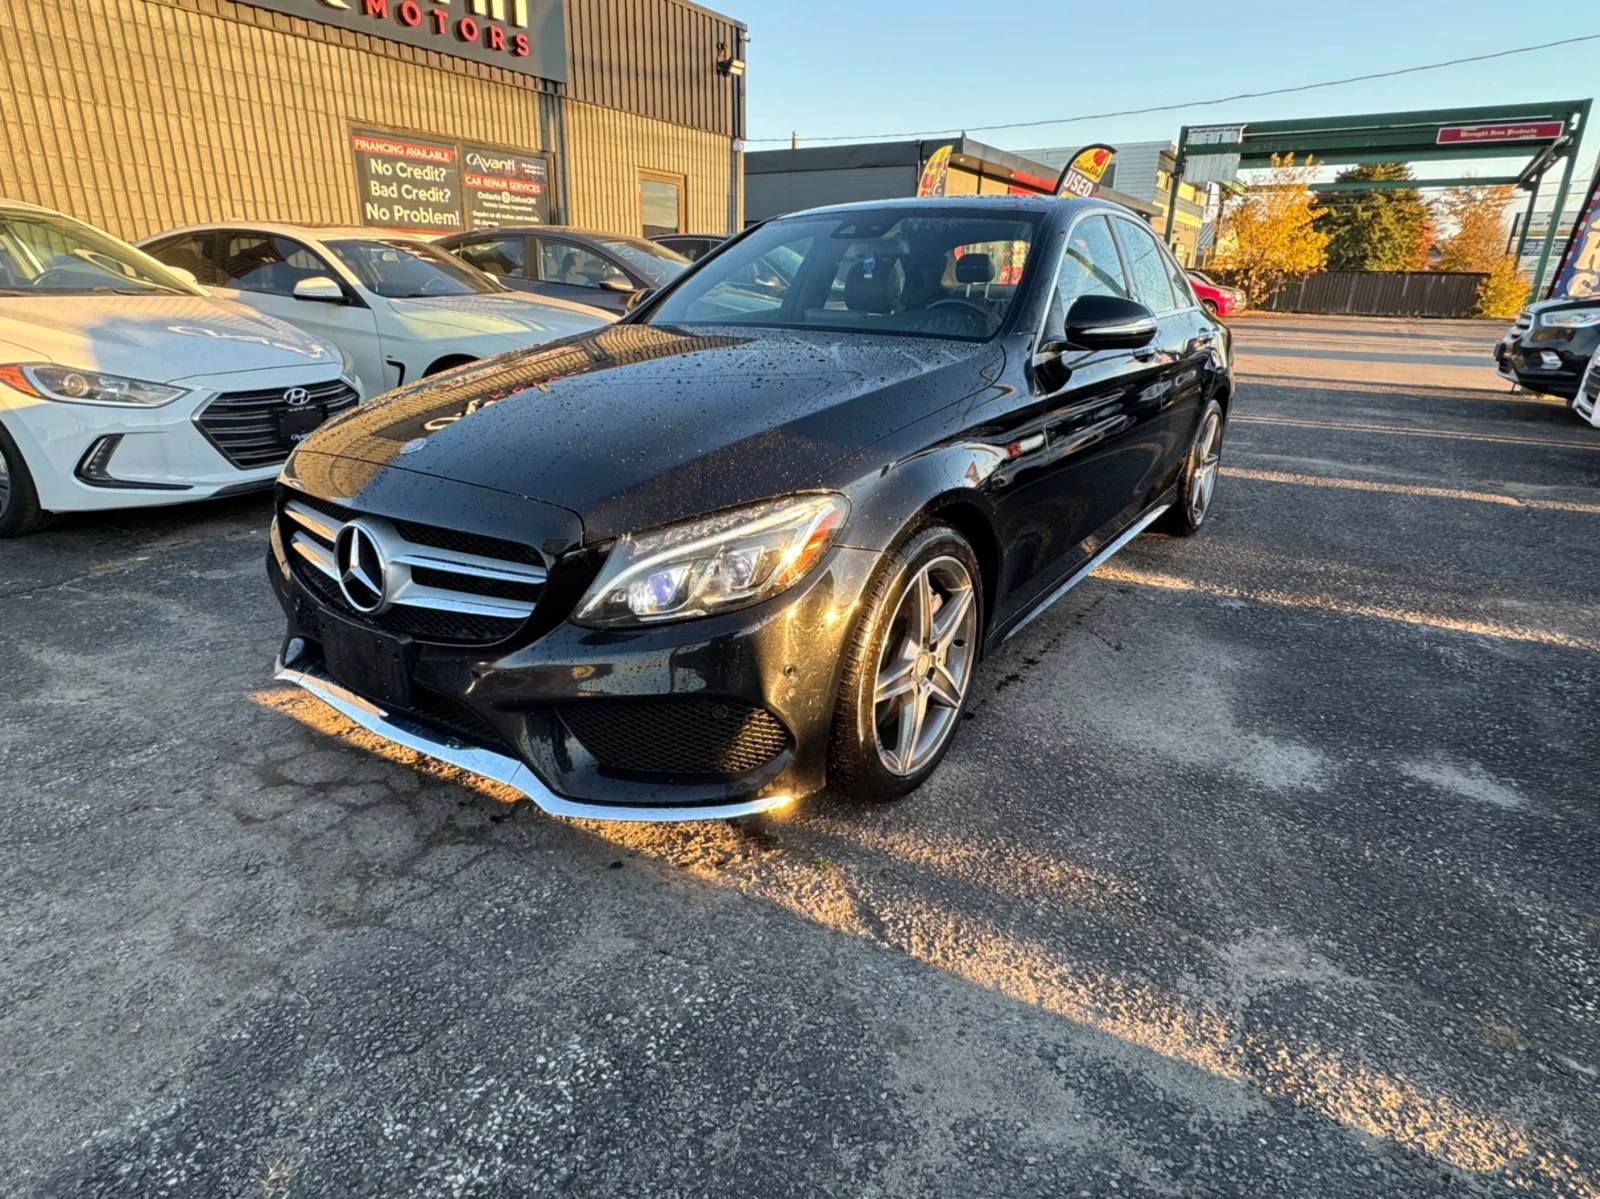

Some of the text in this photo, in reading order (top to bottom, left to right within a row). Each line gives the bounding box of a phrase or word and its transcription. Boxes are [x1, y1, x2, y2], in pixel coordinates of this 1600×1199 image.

[366, 0, 530, 57] MOTORS
[1506, 128, 1538, 136] Products
[354, 139, 450, 160] FINANCING AVAILABLE
[370, 158, 447, 182] No Credit?
[1072, 160, 1101, 180] Quality
[370, 180, 451, 203] Bad Credit?
[465, 176, 540, 193] CAR REPAIR SERVICES
[1063, 170, 1094, 197] USED
[477, 190, 501, 202] Ontario
[365, 202, 460, 226] No Problem!
